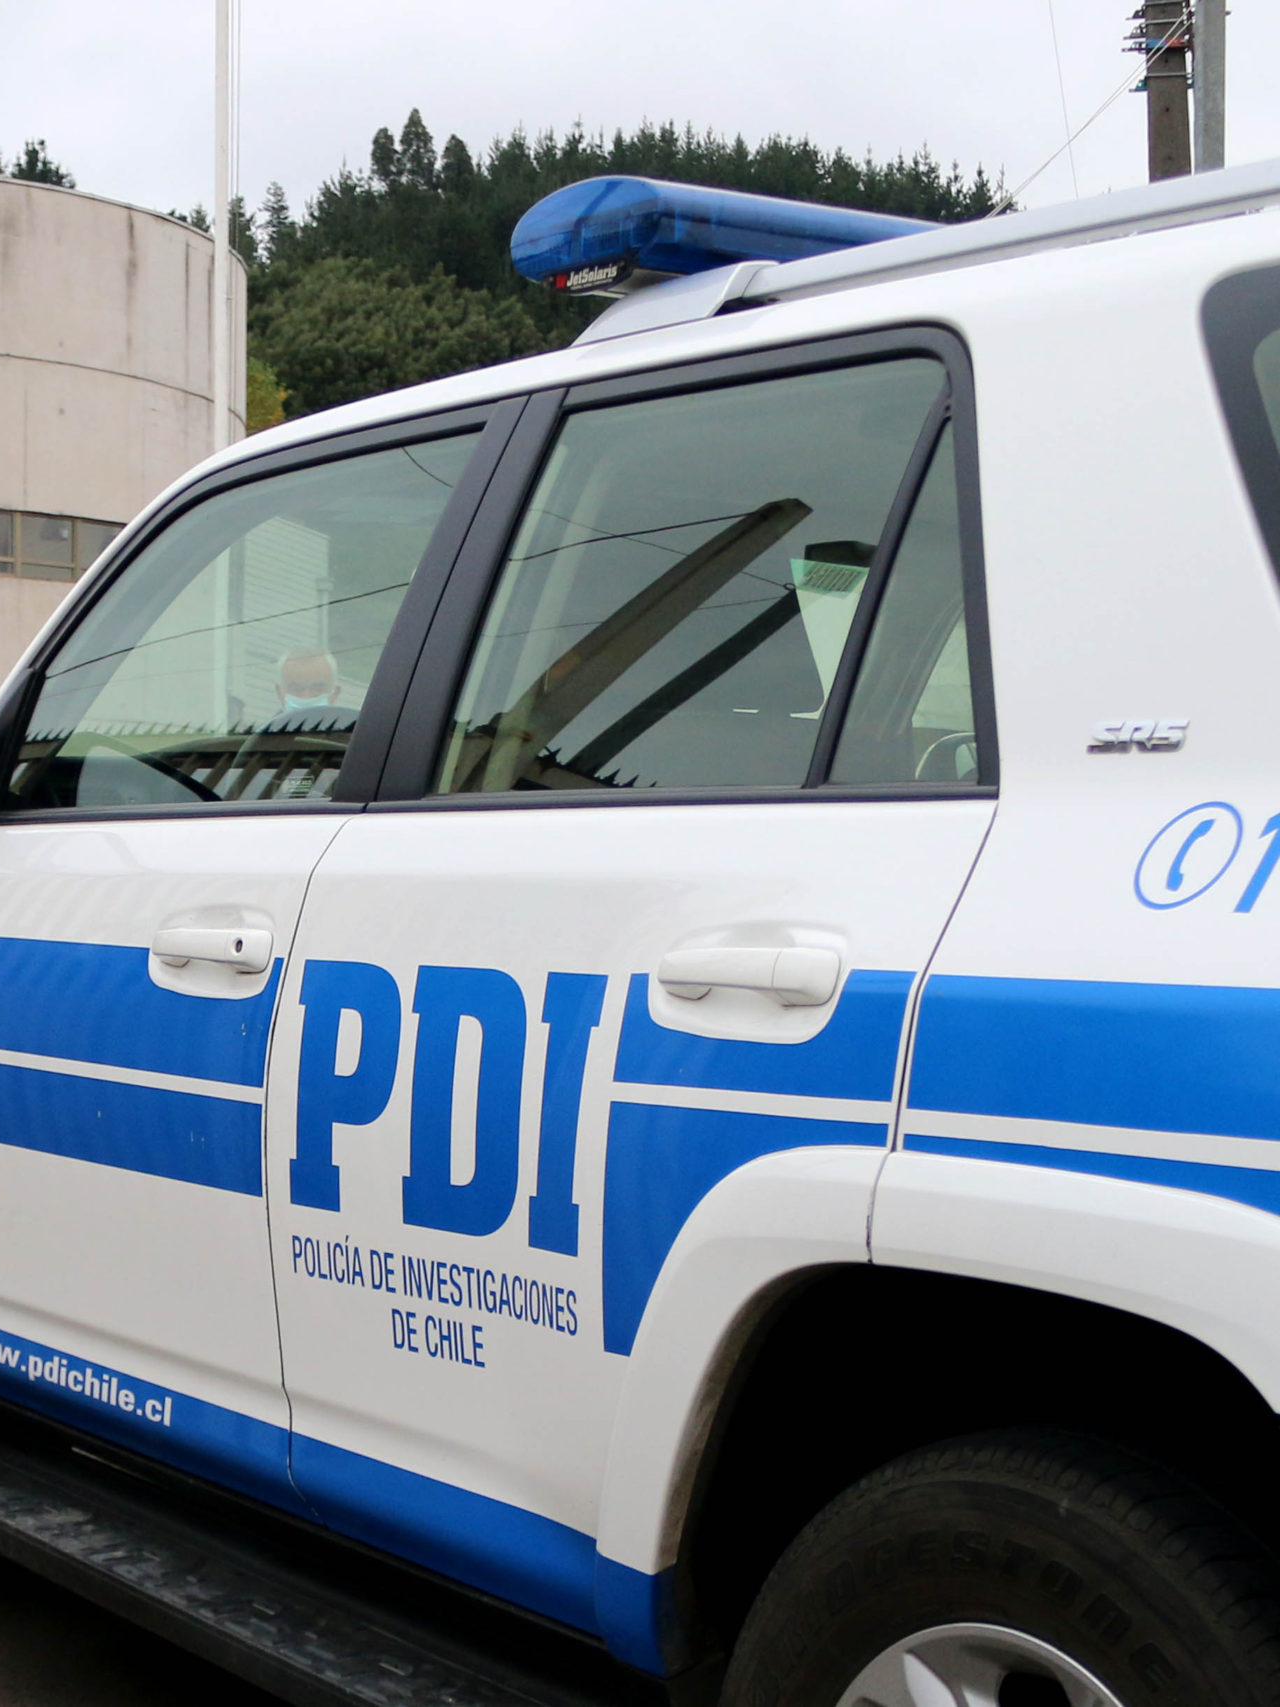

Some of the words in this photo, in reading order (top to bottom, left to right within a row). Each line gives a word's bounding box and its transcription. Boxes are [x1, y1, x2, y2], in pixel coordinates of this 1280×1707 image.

[290, 959, 608, 1257] PDI
[292, 1235, 365, 1287] POLICÍA
[370, 1249, 396, 1293] DE
[402, 1256, 578, 1336] INVESTIGACIONES
[391, 1308, 419, 1352] DE
[425, 1315, 485, 1368] CHILE
